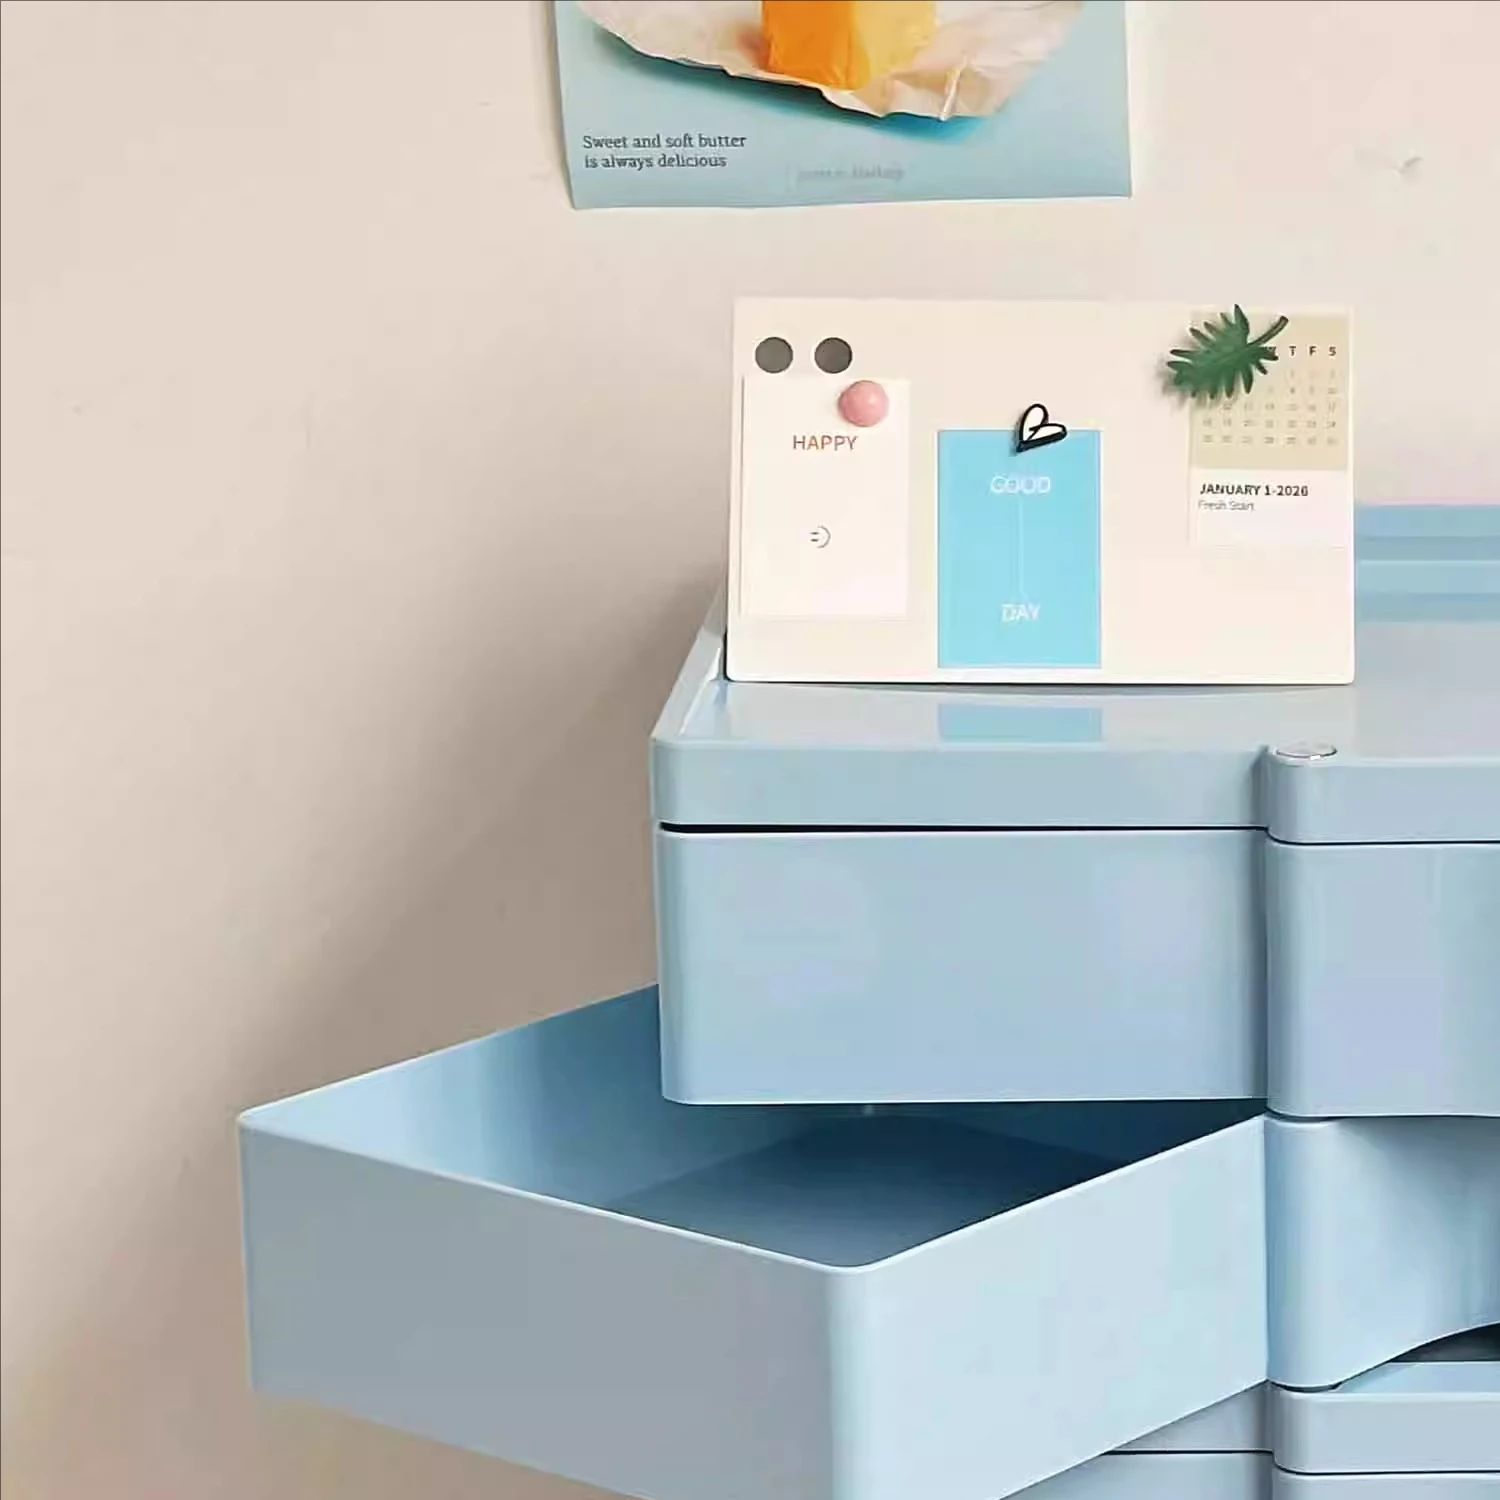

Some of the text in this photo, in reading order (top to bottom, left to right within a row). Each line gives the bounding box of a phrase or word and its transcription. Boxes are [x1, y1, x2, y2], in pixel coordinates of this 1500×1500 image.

[583, 133, 747, 149] Sweet and soft butter
[584, 153, 727, 171] is always delicious
[1289, 346, 1336, 356] T F S
[793, 435, 858, 451] HAPPY
[1200, 484, 1260, 496] JANUARY
[1001, 603, 1041, 621] DAY
